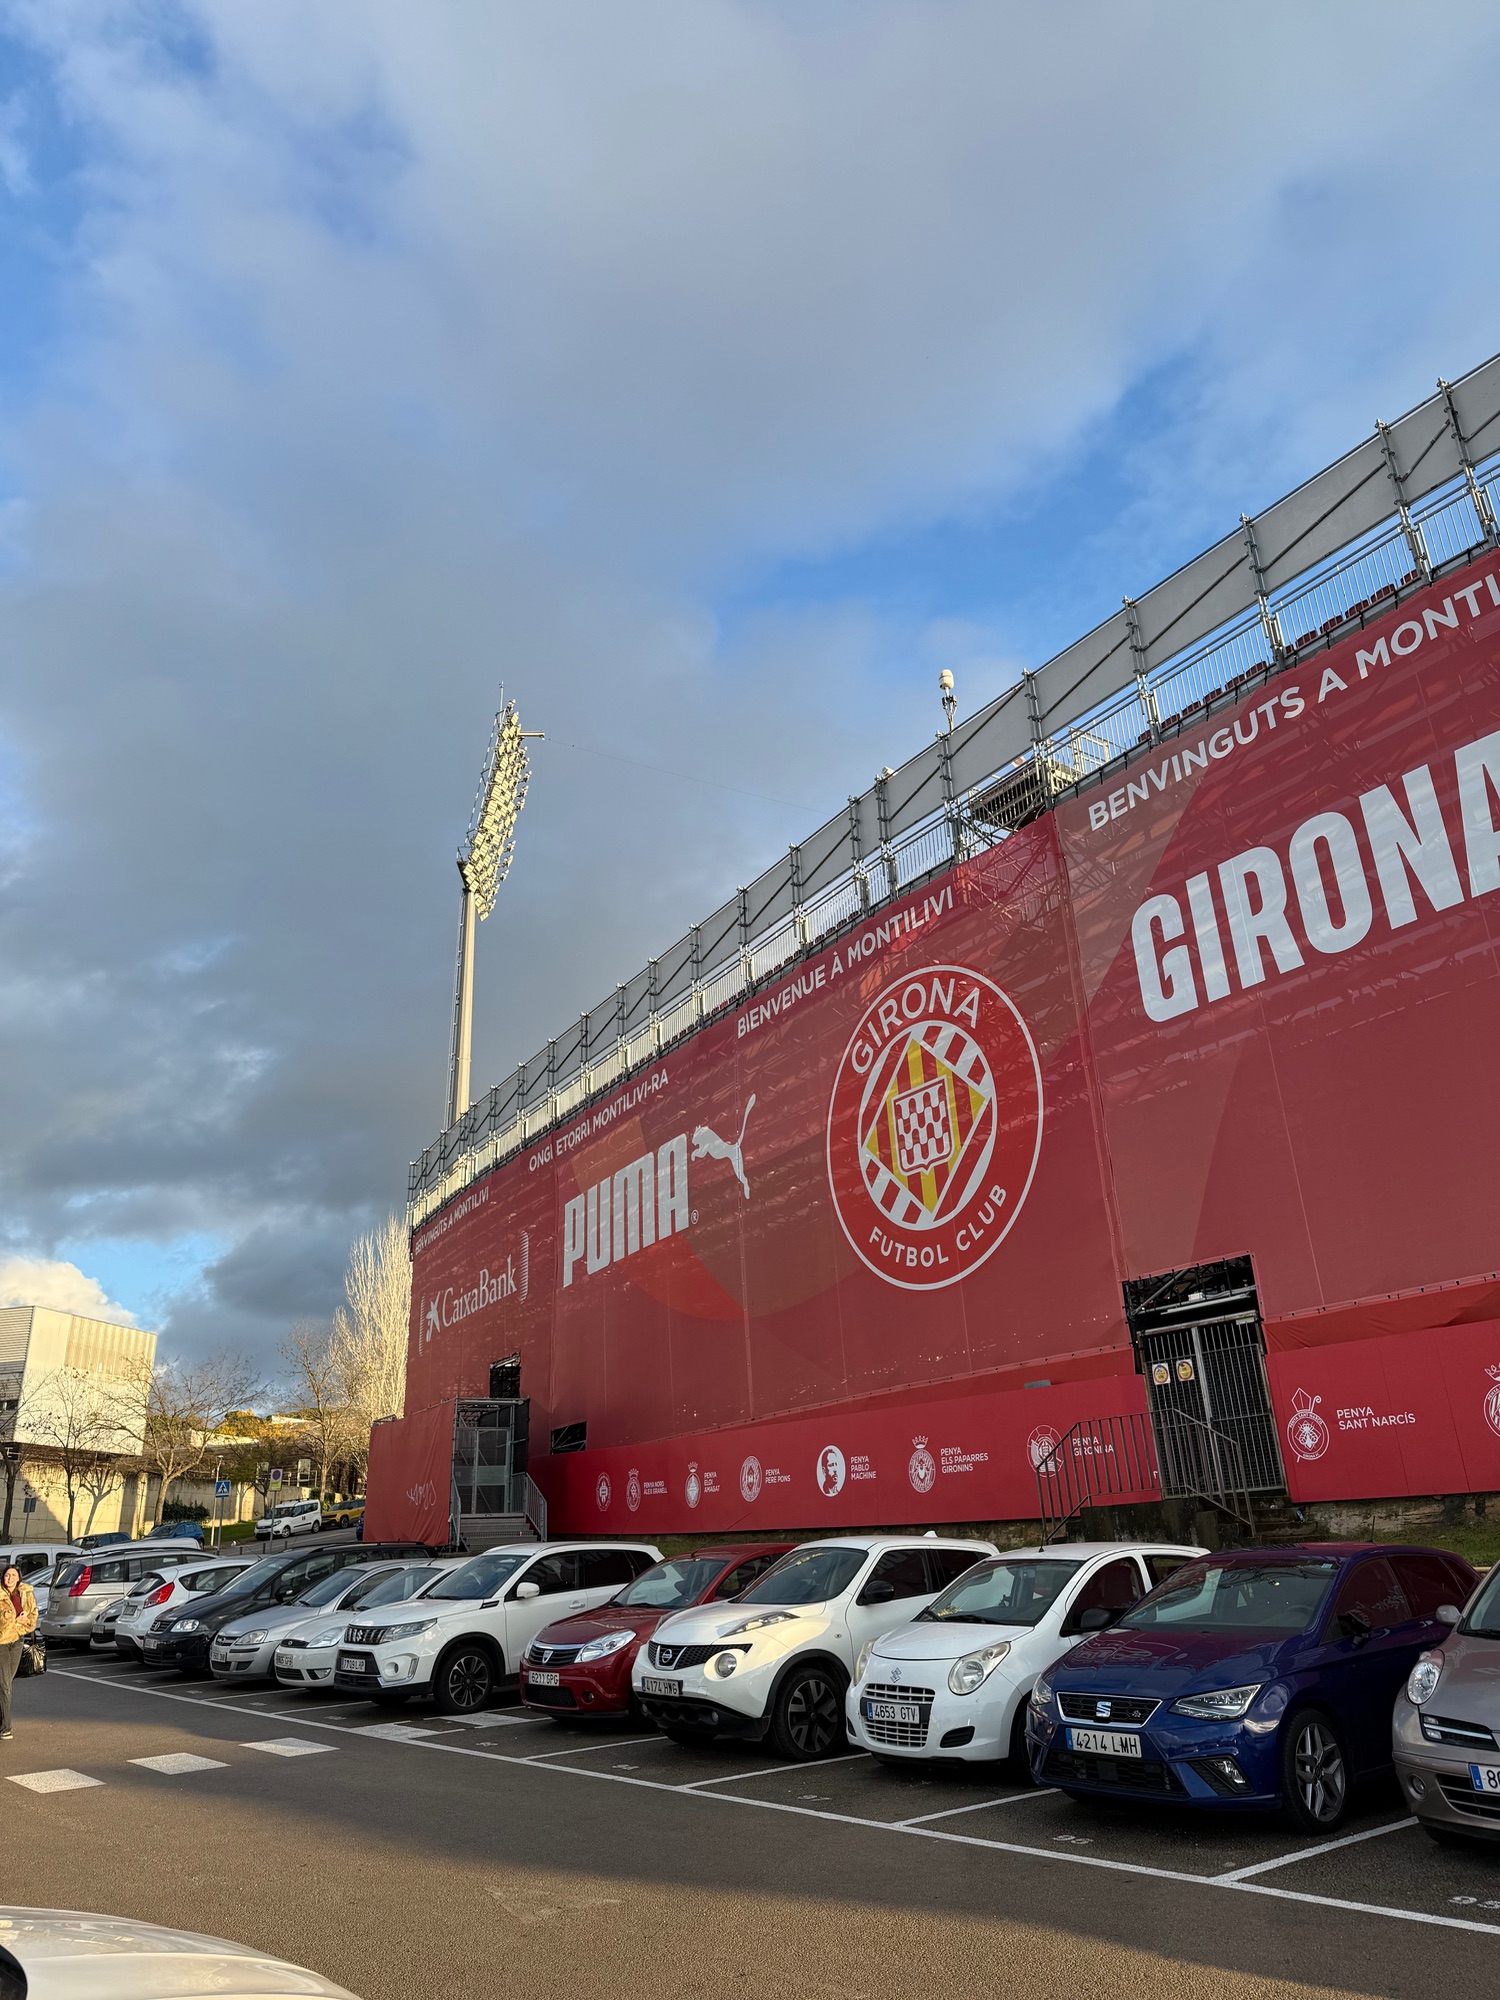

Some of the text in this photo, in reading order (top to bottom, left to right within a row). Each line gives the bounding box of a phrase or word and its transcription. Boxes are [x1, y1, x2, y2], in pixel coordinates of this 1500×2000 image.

[1087, 685, 1306, 832] BENVINGUTS
[1317, 667, 1349, 704] A
[1131, 730, 1500, 1023] GIRONA
[737, 885, 954, 1039] BIENVENUE À MONTILIVI
[851, 977, 981, 1074] GIRONA
[529, 1068, 669, 1172] ONGI ETORRI MONTILIVI-RA
[453, 1186, 489, 1224] MONTILIVI
[563, 1133, 690, 1288] PUMA
[869, 1183, 1007, 1268] FUTBOL CLUB
[442, 1254, 518, 1328] CaixaBank
[1336, 1406, 1374, 1419] PENYA
[1338, 1411, 1416, 1431] SANT NARCÍS
[850, 1455, 869, 1463] PENYA
[940, 1447, 962, 1456] PENYA
[941, 1452, 989, 1465] ELS PAPARRES
[704, 1471, 717, 1479] PENYA
[765, 1468, 780, 1476] PENYA
[850, 1463, 870, 1472] PABLO
[850, 1471, 877, 1480] MACHINE
[941, 1464, 974, 1474] GIRONINS
[765, 1475, 791, 1484] PERE PONS
[532, 1672, 545, 1684] 6211
[646, 1679, 662, 1693] 4174
[874, 1705, 916, 1722] 4653 GTV
[1076, 1732, 1138, 1755] 4214 LMH
[1487, 1769, 1500, 1789] 8
